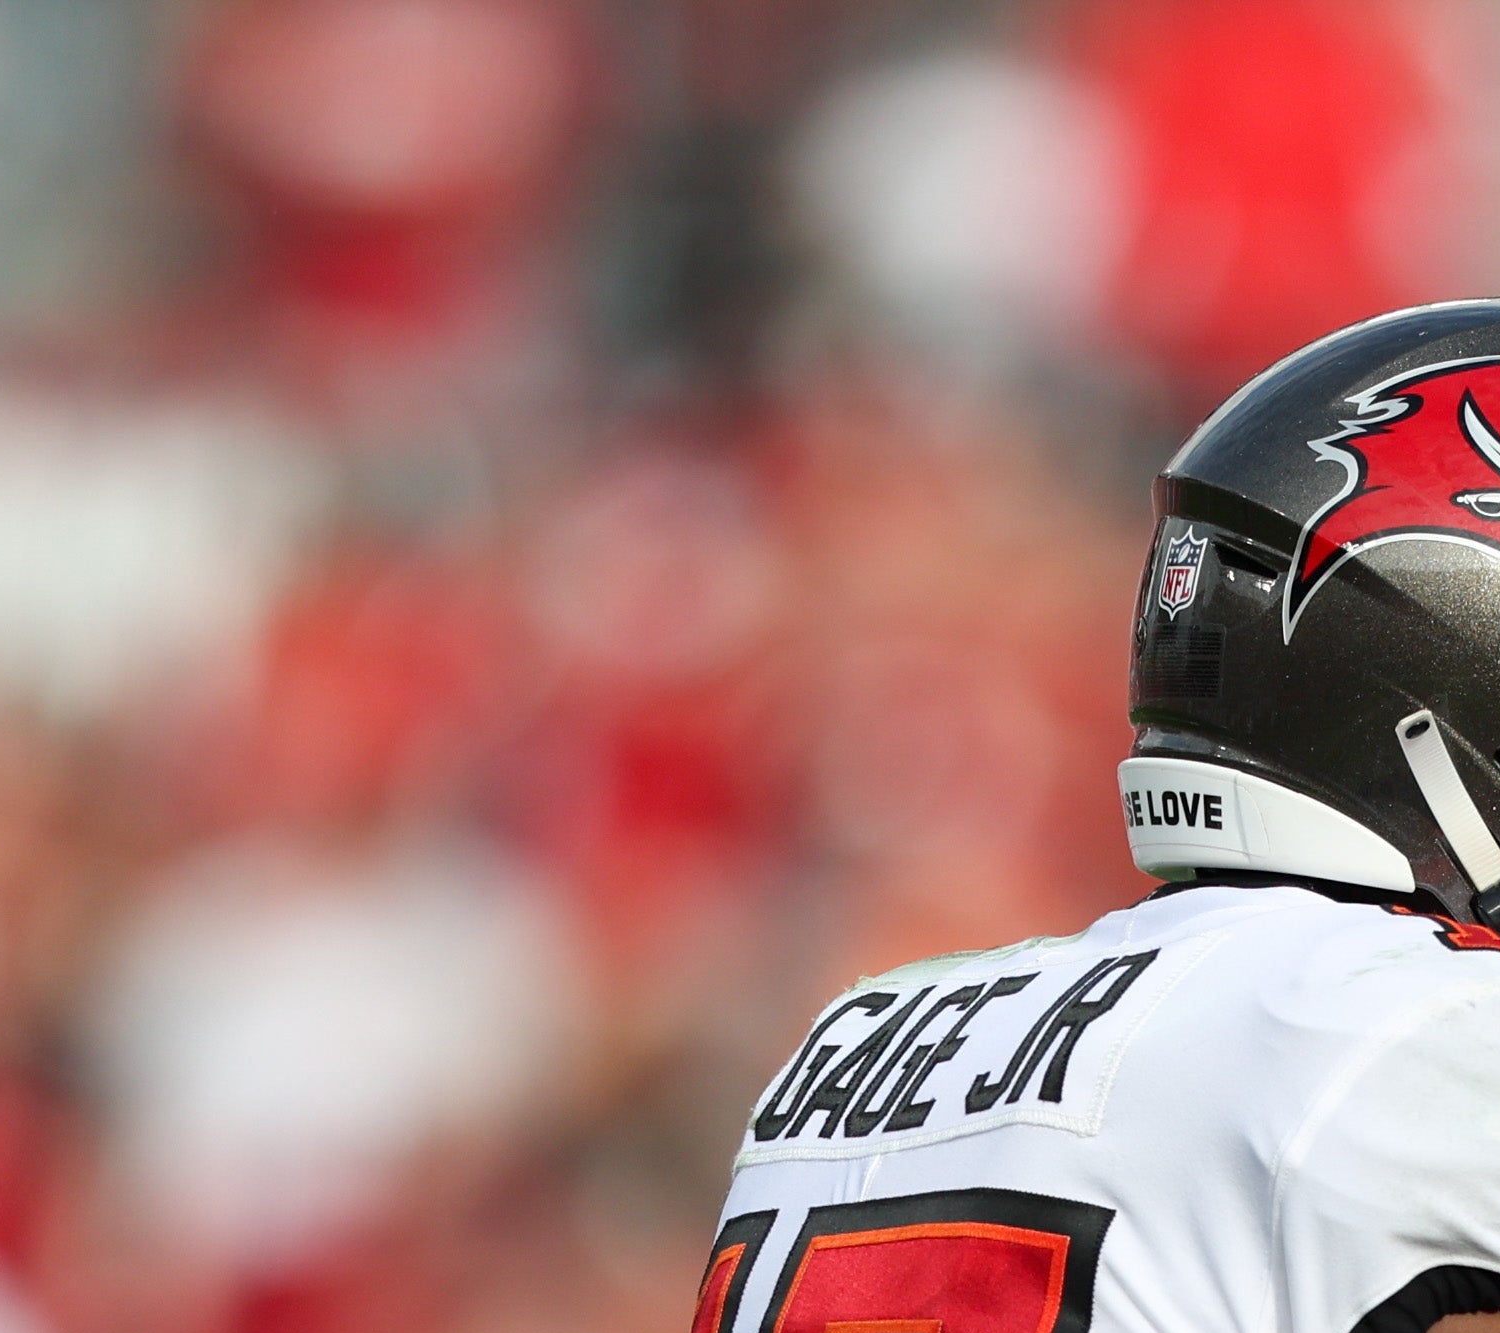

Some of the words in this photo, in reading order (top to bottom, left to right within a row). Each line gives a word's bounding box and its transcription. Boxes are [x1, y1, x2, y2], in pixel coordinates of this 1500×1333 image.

[1163, 566, 1192, 603] NFL
[1146, 789, 1223, 830] LOVE
[753, 970, 1042, 1143] GAGE
[964, 947, 1161, 1115] JR
